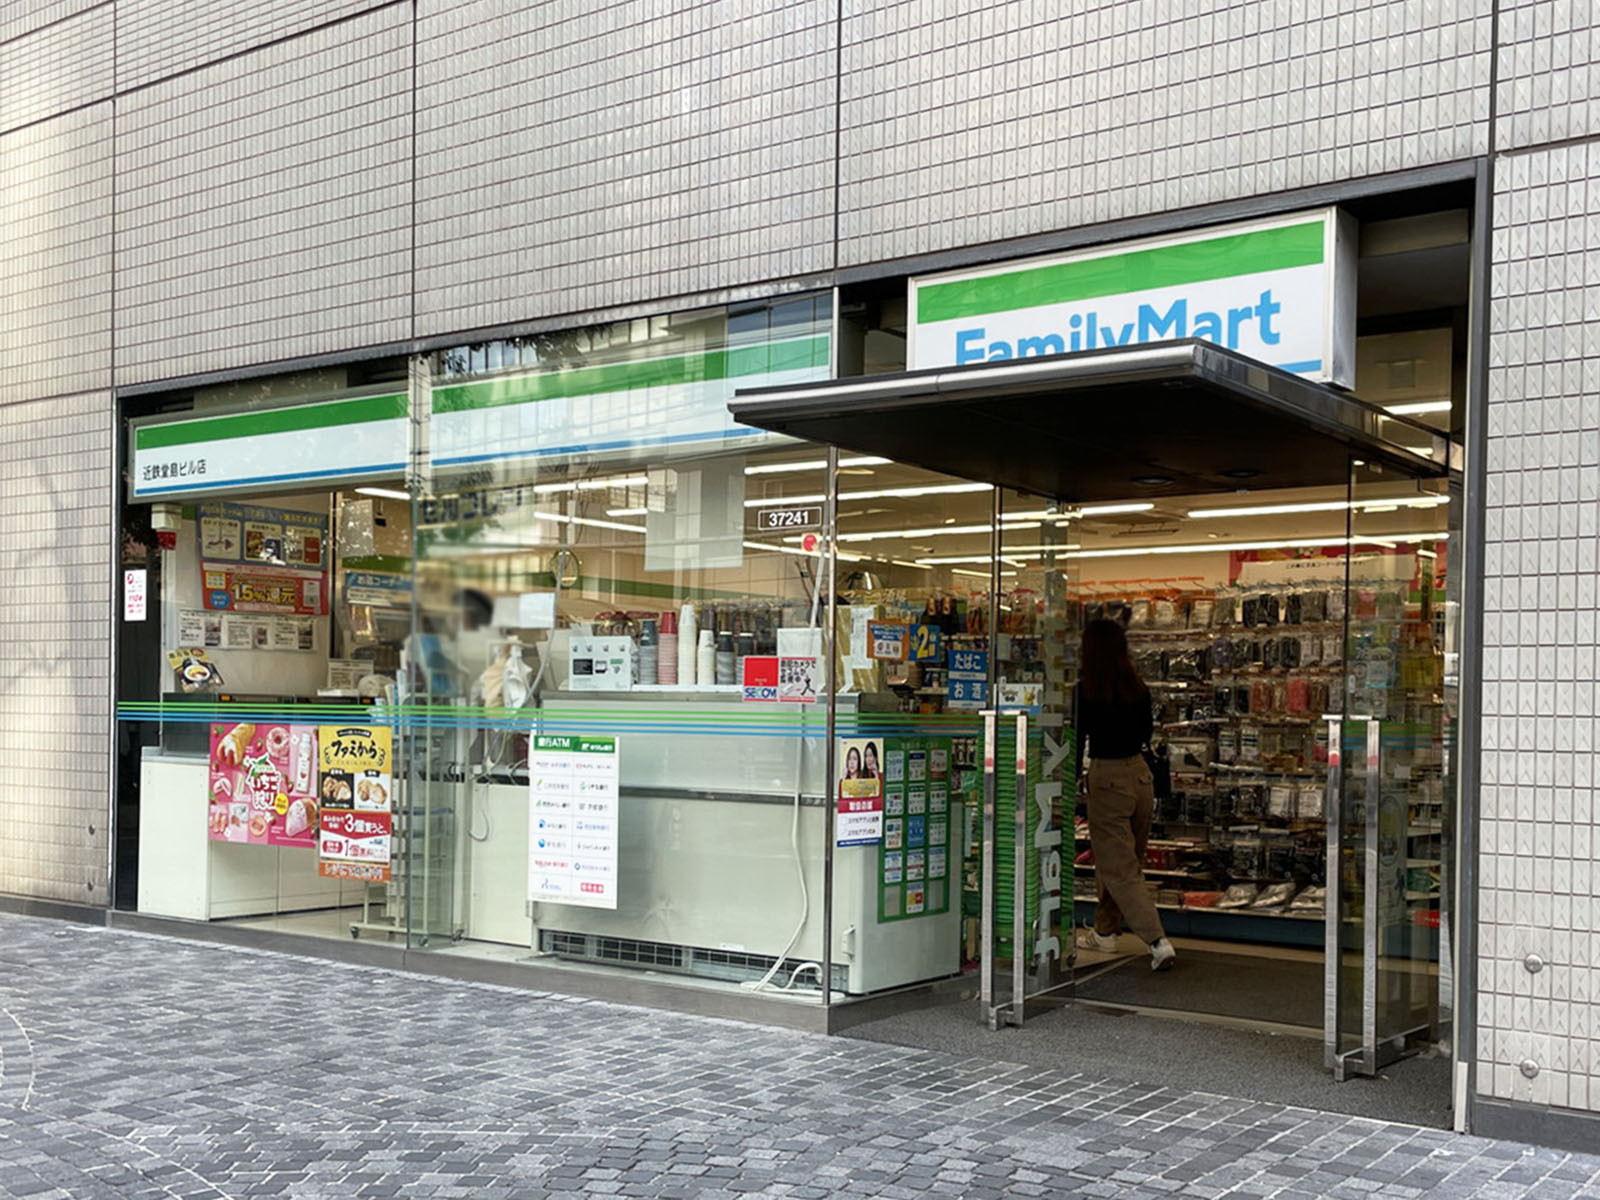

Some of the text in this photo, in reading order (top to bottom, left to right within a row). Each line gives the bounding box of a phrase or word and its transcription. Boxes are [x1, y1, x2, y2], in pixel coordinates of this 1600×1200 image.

[769, 511, 809, 527] 37241
[954, 653, 981, 670] たばこ
[745, 687, 777, 699] SECOM
[954, 682, 982, 699] お酒
[331, 739, 378, 759] ファミから
